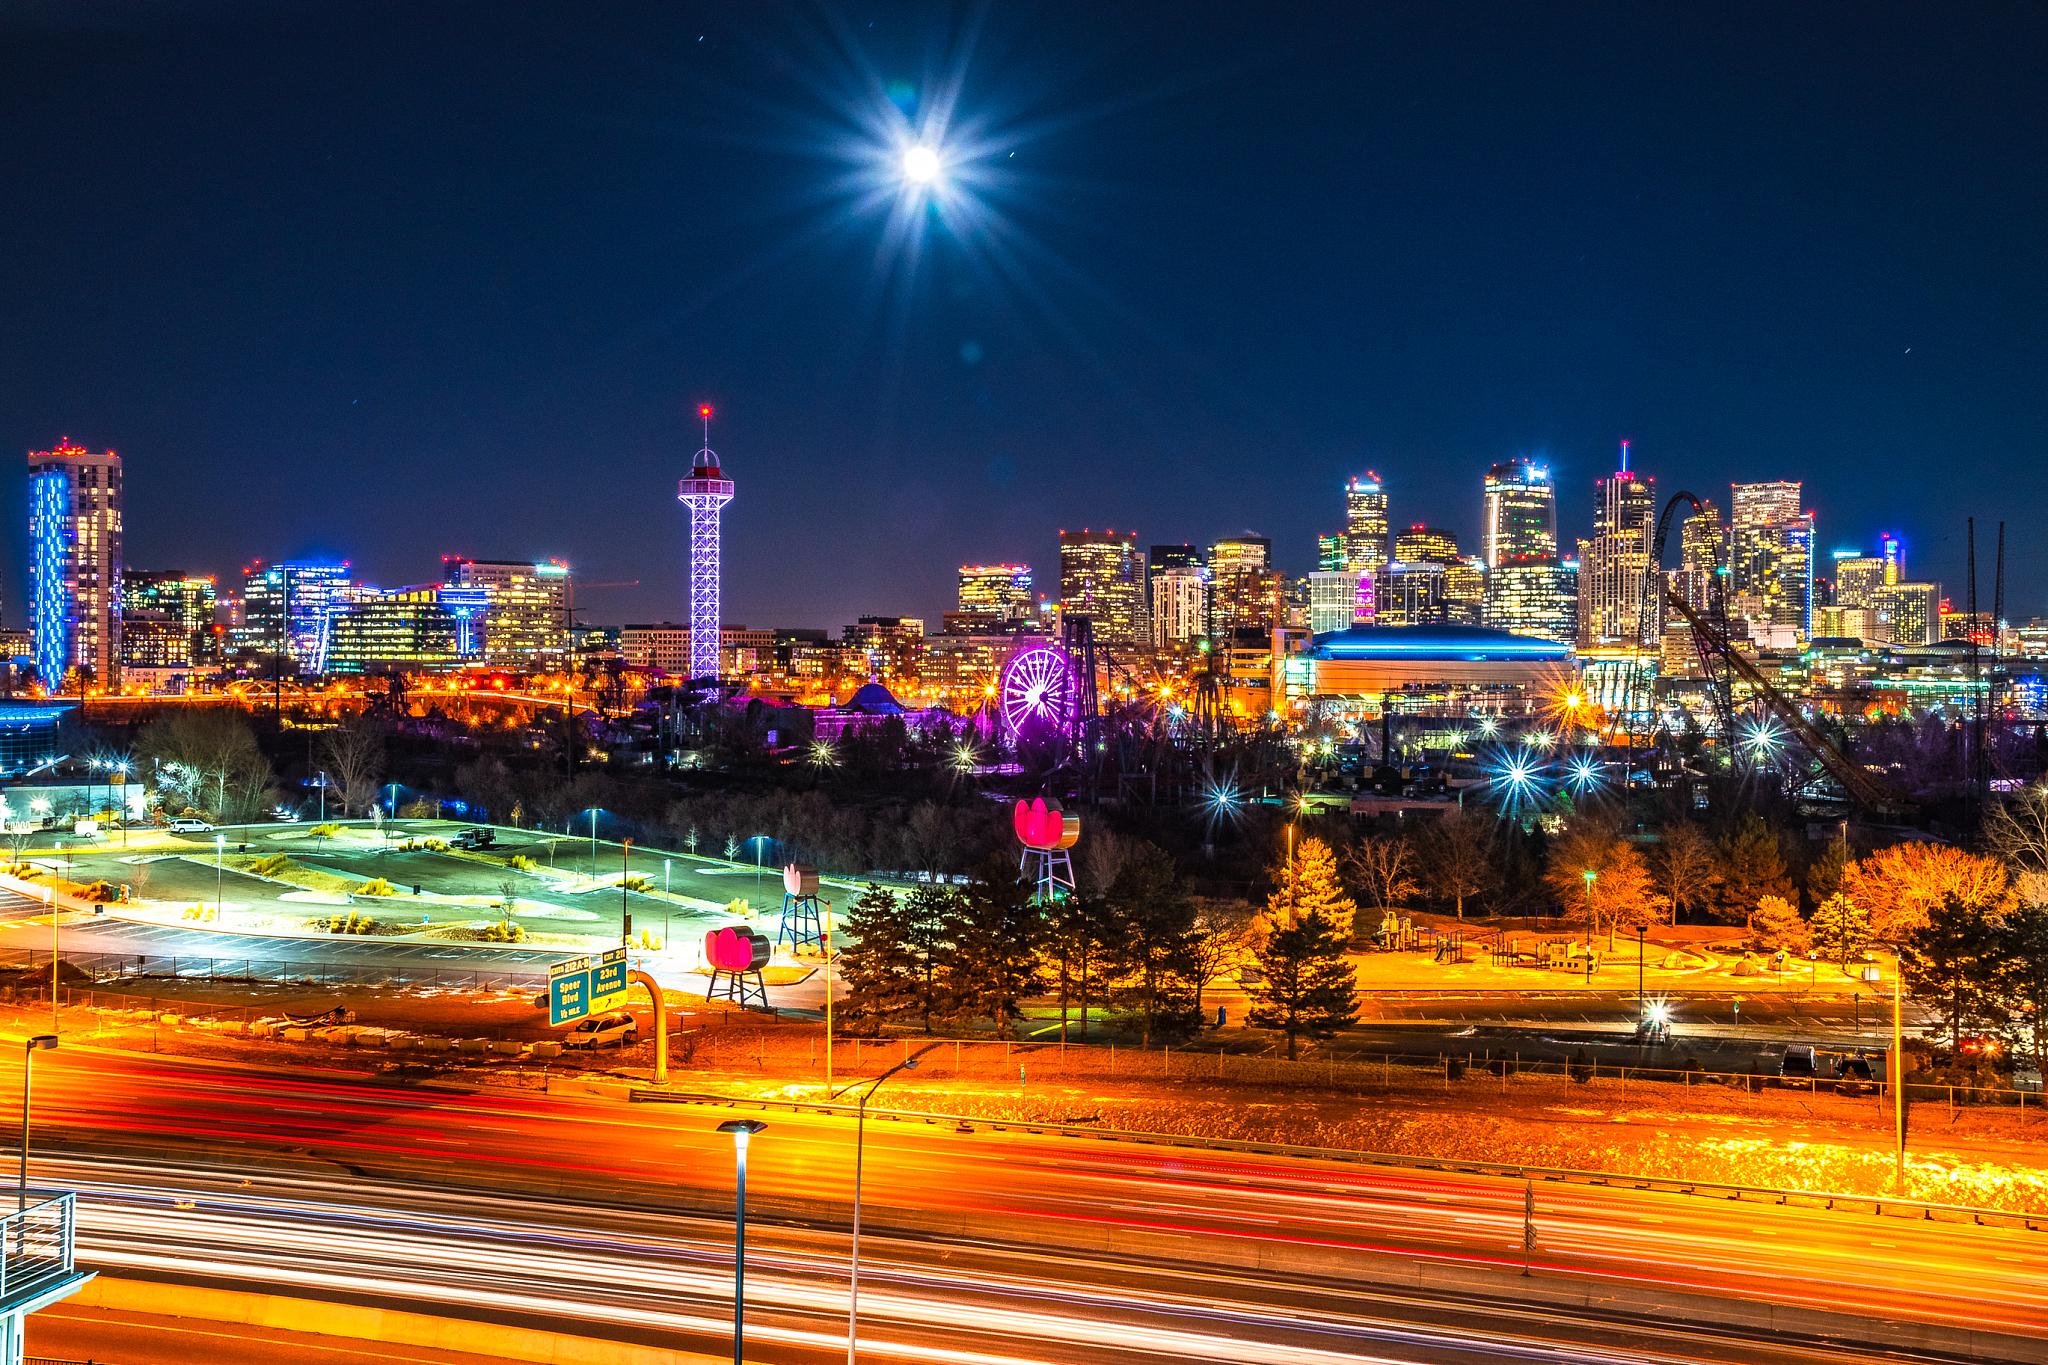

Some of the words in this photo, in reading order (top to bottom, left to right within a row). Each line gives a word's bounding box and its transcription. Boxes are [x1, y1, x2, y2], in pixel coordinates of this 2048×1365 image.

[615, 949, 625, 959] 211
[600, 966, 617, 980] 23rd
[559, 980, 581, 993] Speer
[596, 979, 621, 993] Avenue
[562, 991, 579, 1005] Blvd
